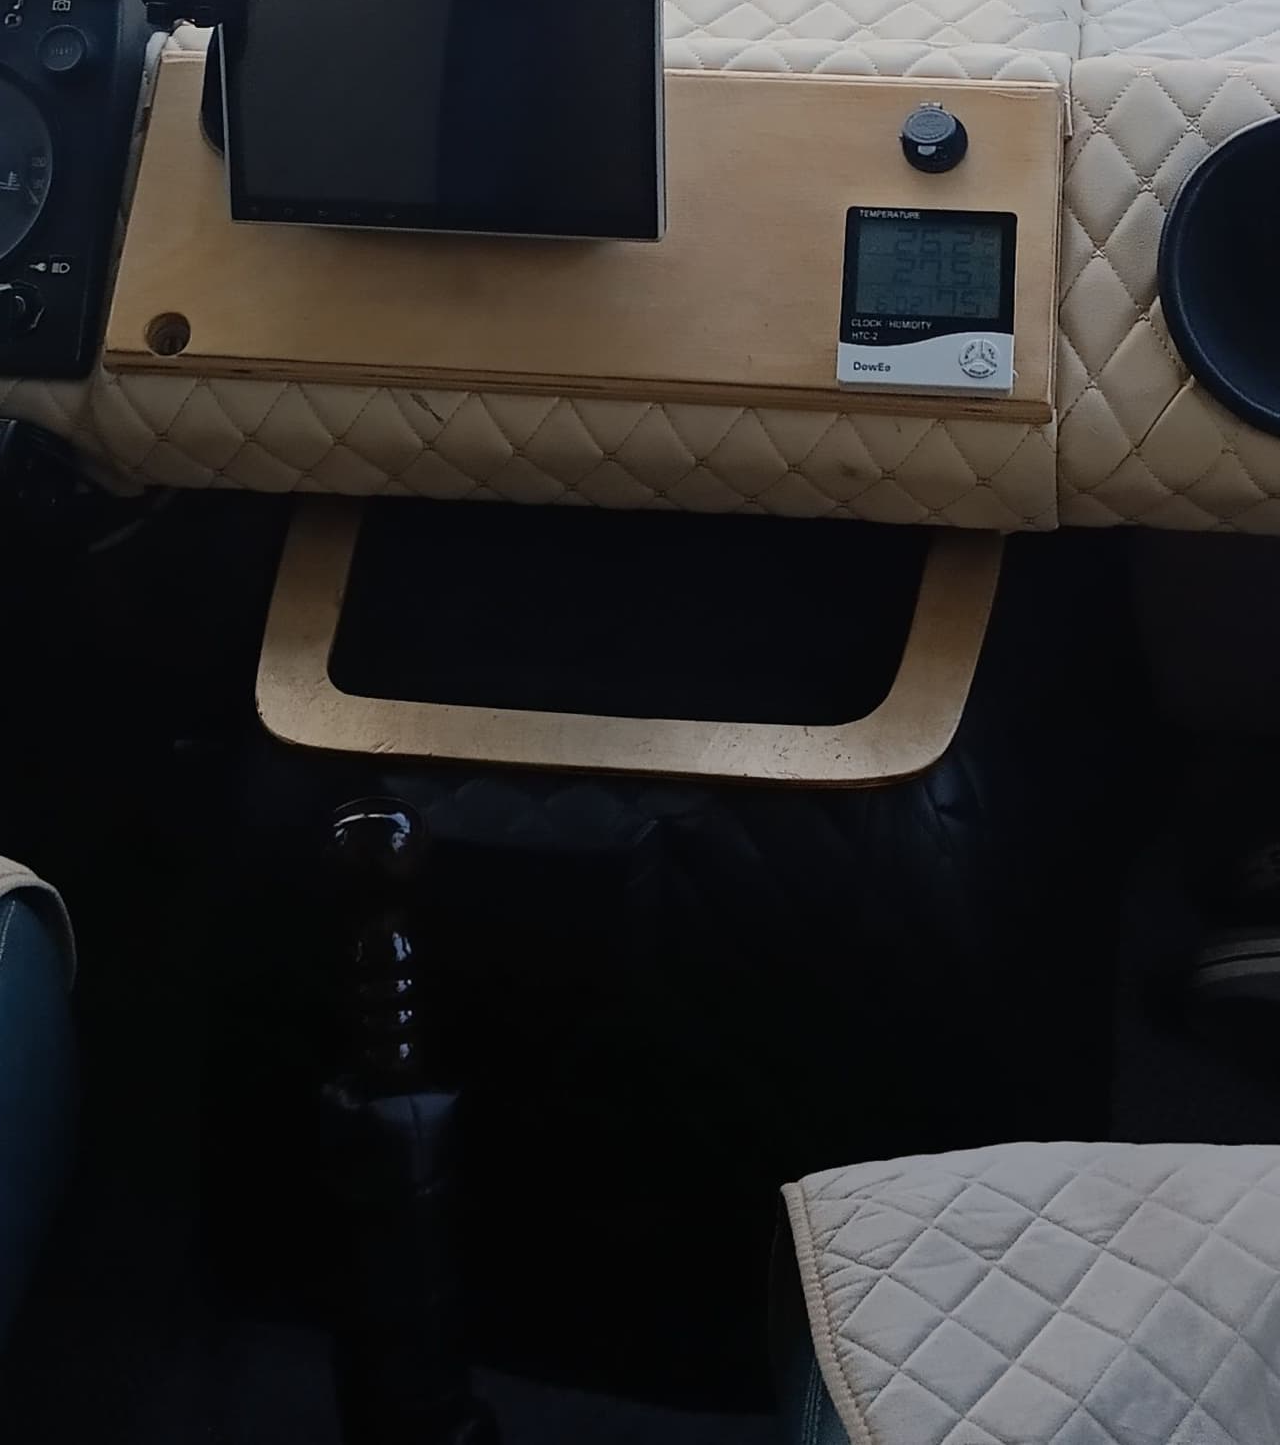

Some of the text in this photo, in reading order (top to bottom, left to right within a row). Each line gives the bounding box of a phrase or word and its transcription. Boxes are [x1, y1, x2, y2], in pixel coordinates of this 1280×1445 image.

[859, 209, 920, 220] TEMPERATURE
[851, 318, 932, 330] CLOCK HUMIDITY
